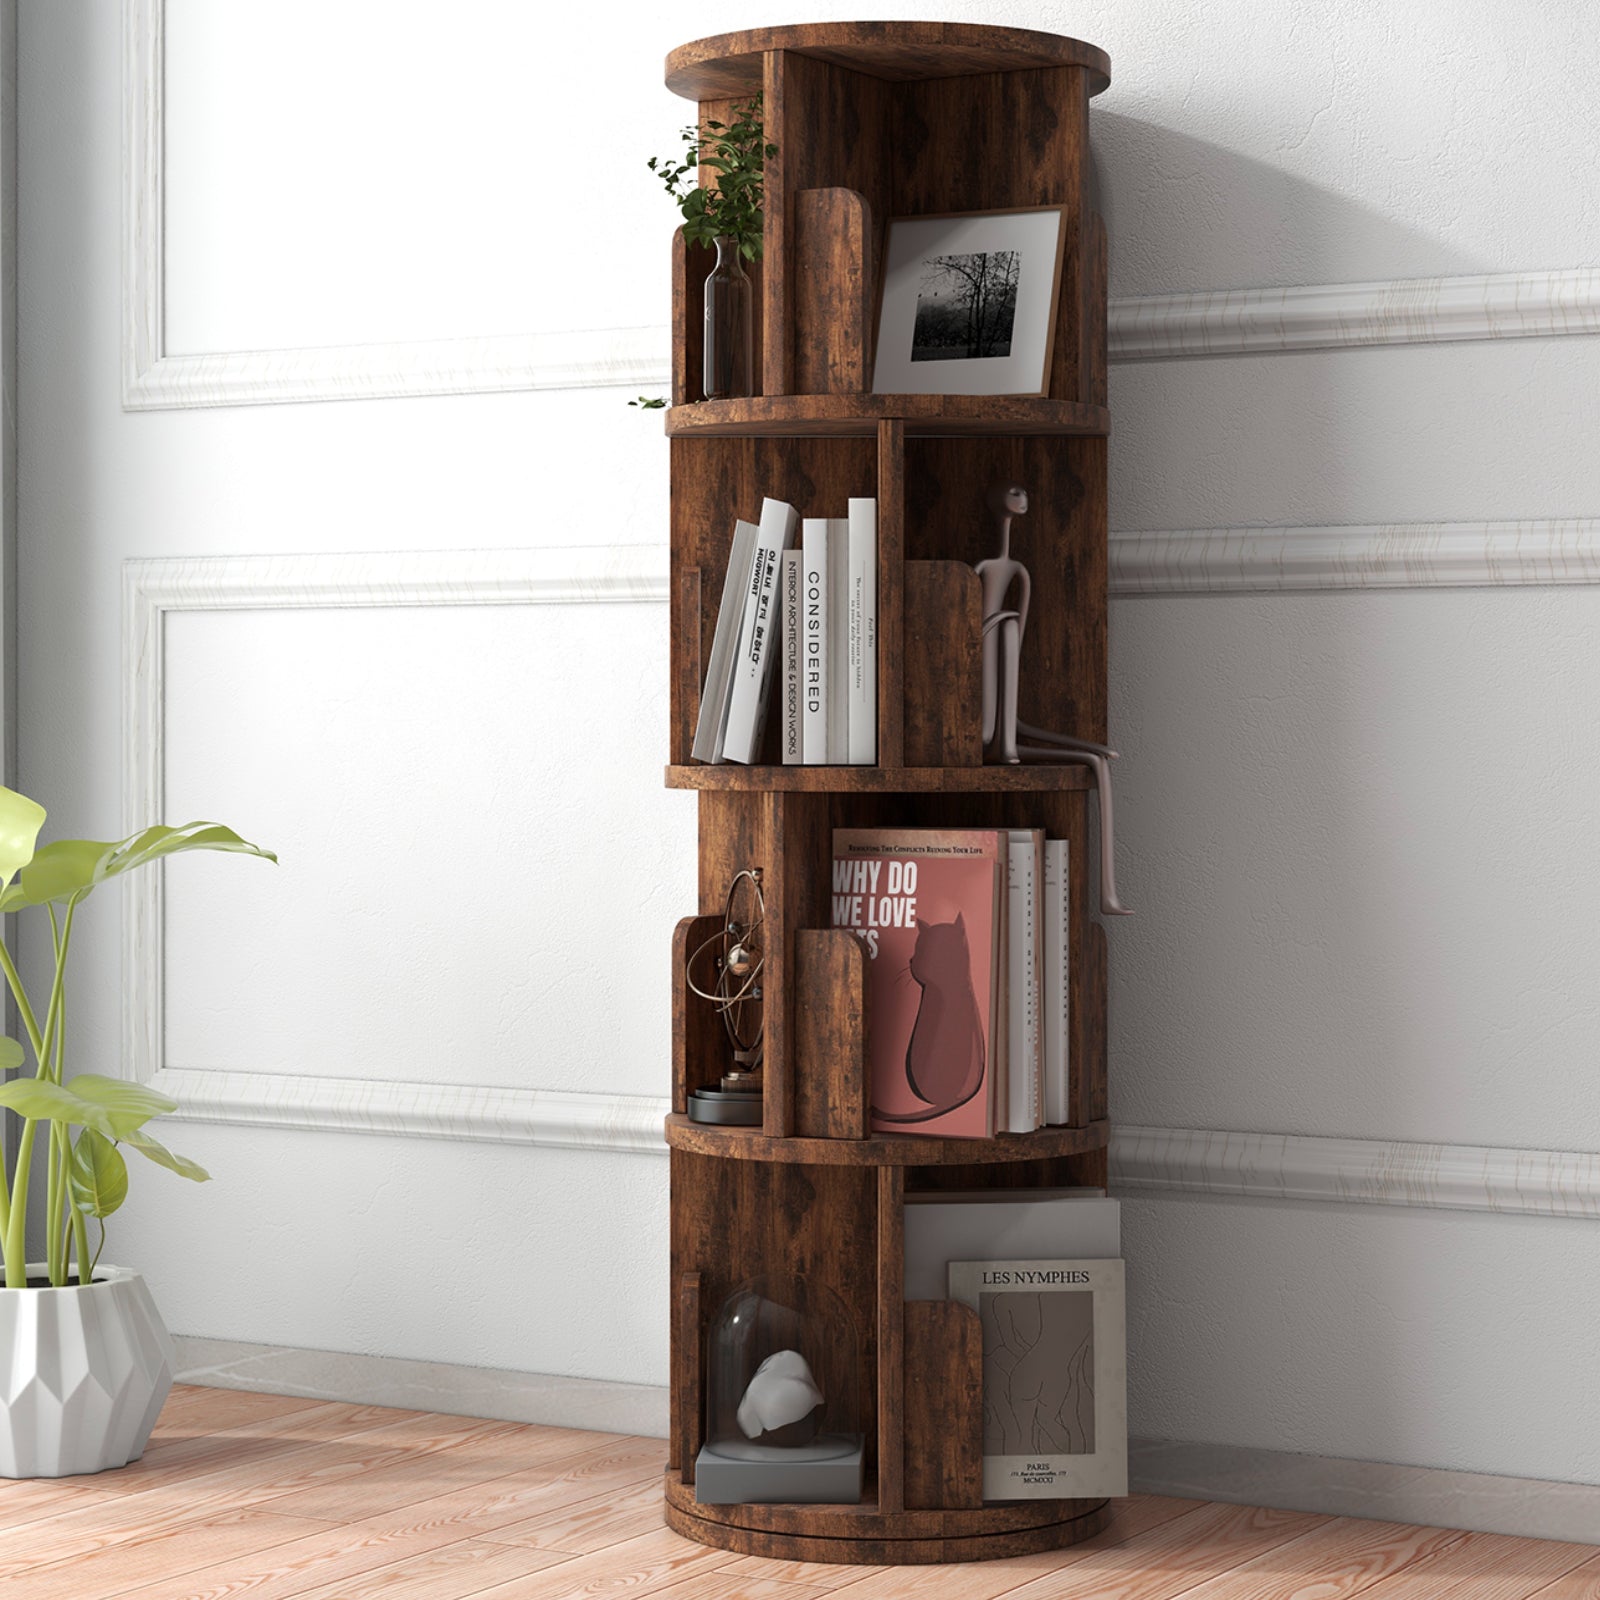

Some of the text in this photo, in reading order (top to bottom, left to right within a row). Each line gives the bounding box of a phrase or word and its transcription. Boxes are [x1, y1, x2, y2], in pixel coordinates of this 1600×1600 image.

[751, 548, 764, 596] MUGWORT
[788, 561, 797, 756] INTERIOR ARCHITECTURE & DESIGN WORKS
[808, 571, 820, 713] CONSIDERED
[833, 860, 918, 895] WHY DO
[832, 896, 917, 928] WE LOVE
[982, 1270, 1090, 1285] LES NYMPHES
[1026, 1463, 1050, 1471] PARIS
